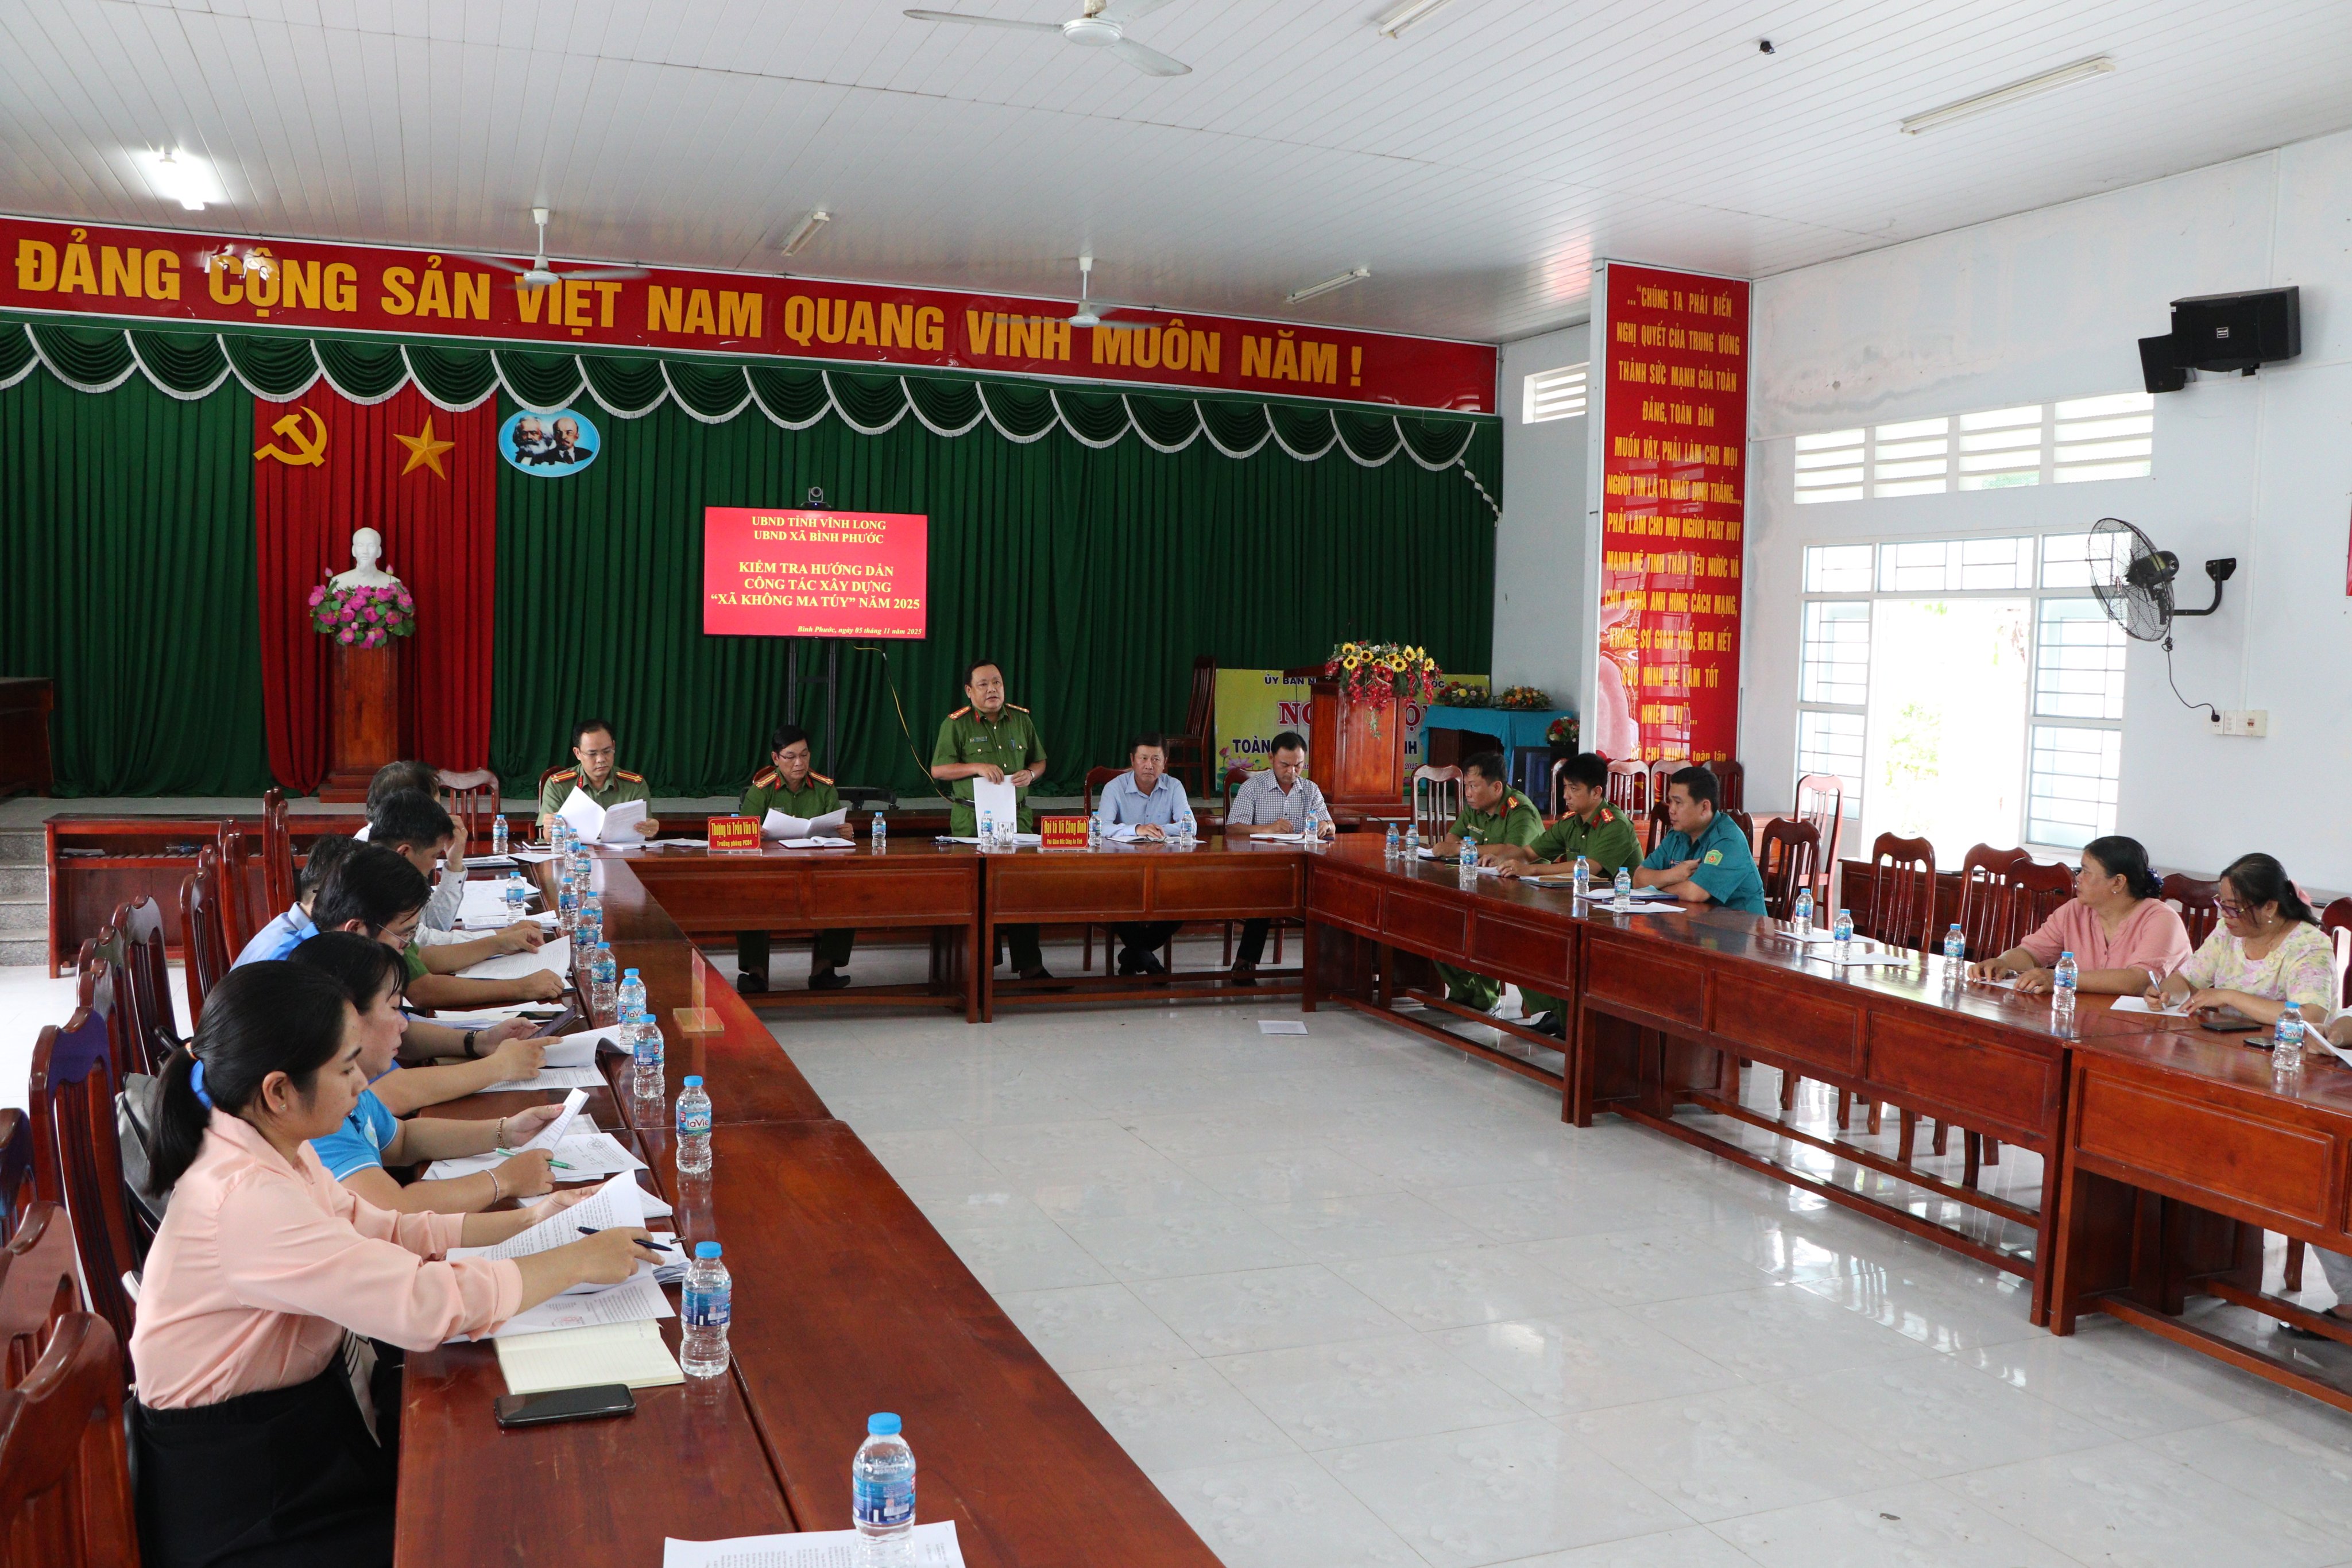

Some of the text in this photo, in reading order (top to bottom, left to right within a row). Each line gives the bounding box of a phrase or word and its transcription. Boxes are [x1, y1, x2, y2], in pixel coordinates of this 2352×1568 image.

[16, 229, 180, 300] ĐẢNG
[208, 246, 358, 318] CỘNG
[381, 255, 490, 320] SẢN
[514, 274, 622, 336] VIỆT
[648, 285, 763, 338] NAM
[785, 295, 945, 351] QUANG
[966, 309, 1070, 362] VINH
[1093, 319, 1221, 374] MUÔN
[1241, 329, 1337, 385] NĂM
[1673, 291, 1683, 311] TA
[1689, 288, 1708, 314] PHẢI
[1713, 291, 1731, 317] BIẾN
[1617, 320, 1740, 355] NGHỊ QUYẾT CỦA TRUNG ƯƠNG
[1619, 357, 1736, 392] THÀNH SỨC MẠNH CỦA TOÀN
[1642, 396, 1714, 427] ĐẢNG, TOÀN DÂN
[1615, 431, 1738, 470] MUỐN VẬY, PHẢI LÀM CHO MỌI
[1634, 476, 1646, 496] TIN
[1648, 474, 1657, 497] LÀ
[1659, 479, 1668, 498] TA
[1670, 474, 1689, 500] NHẤT
[1692, 481, 1708, 505] ĐỊNH
[752, 515, 886, 530] UBND TỈNH VĨNH LONG
[754, 529, 884, 544] UBND XÃ BÌNH PHƯỚC
[1607, 507, 1626, 533] PHẢI
[1628, 511, 1646, 535] LÀM
[1649, 516, 1664, 536] CHO
[1665, 517, 1680, 541] MỌI
[1707, 517, 1724, 540] PHÁT
[1726, 521, 1741, 541] HUY
[738, 559, 893, 576] KIỂM TRA HƯỚNG DẪN
[1607, 551, 1630, 575] MẠNH
[1632, 549, 1643, 572] MẼ
[1646, 553, 1664, 574] TINH
[1668, 549, 1687, 574] THẦN
[1691, 552, 1705, 576] YÊU
[1731, 555, 1739, 578] VÀ
[744, 575, 892, 594] CÔNG TÁC XÂY DỰNG
[711, 592, 920, 609] “XÃ KHÔNG MA TÚY” NĂM 2025
[1605, 584, 1738, 618] CHỦ NGHĨA ANH HÙNG CÁCH MẠNG,
[864, 627, 881, 635] tháng
[1610, 624, 1637, 648] KHÔNG
[1640, 626, 1651, 653] SỢ
[1654, 629, 1673, 649] GIAN
[1698, 632, 1714, 651] ĐEM
[1717, 626, 1732, 652] HẾT
[1264, 674, 1279, 684] ỦY
[1283, 677, 1304, 685] BAN
[1622, 662, 1639, 686] SỨC
[1643, 663, 1664, 687] MÌNH
[1683, 664, 1700, 687] LÀM
[1705, 662, 1719, 688] TỐT
[1642, 700, 1667, 728] NHIỆM
[1232, 735, 1271, 754] TOÀN
[1645, 744, 1661, 761] CHÍ
[1664, 747, 1686, 761] MINH
[1693, 750, 1710, 762] toàn
[687, 1118, 709, 1128] laVie
